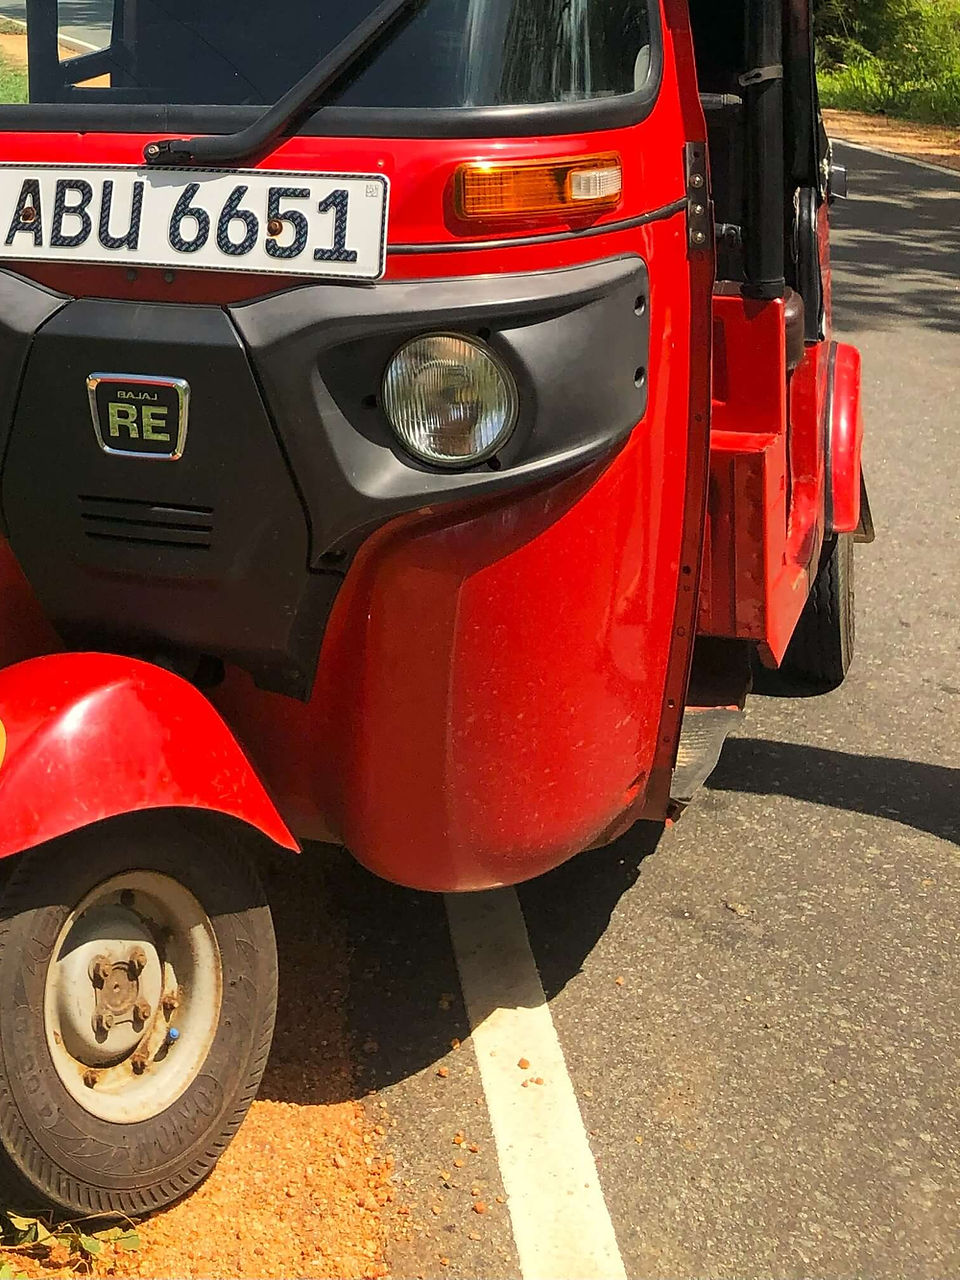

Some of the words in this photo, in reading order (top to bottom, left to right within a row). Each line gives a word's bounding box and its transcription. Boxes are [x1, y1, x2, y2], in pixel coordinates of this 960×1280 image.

[5, 178, 144, 250] ABU
[168, 183, 358, 262] 6651
[117, 391, 158, 401] BAJAJ
[108, 402, 170, 441] RE
